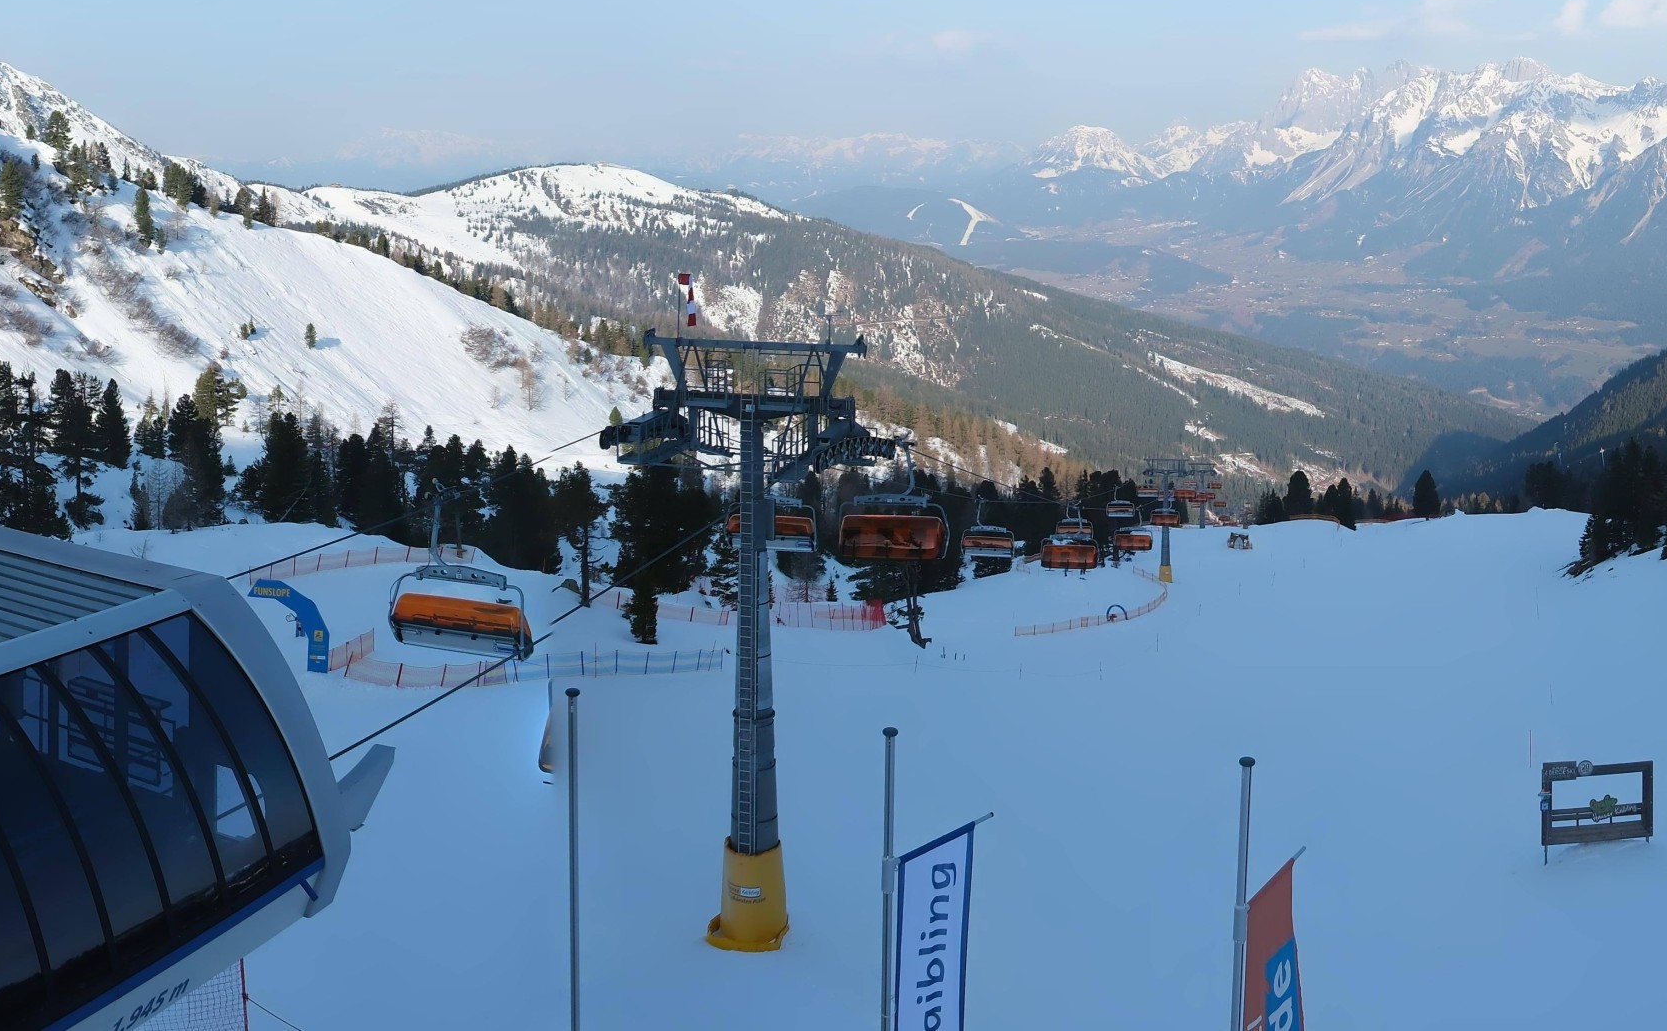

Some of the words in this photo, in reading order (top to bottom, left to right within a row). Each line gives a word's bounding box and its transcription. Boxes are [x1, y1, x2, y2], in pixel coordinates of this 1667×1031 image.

[253, 586, 291, 598] FUNSLOPE
[916, 862, 957, 1031] aibling
[113, 989, 168, 1031] 1.945
[168, 978, 190, 1002] m
